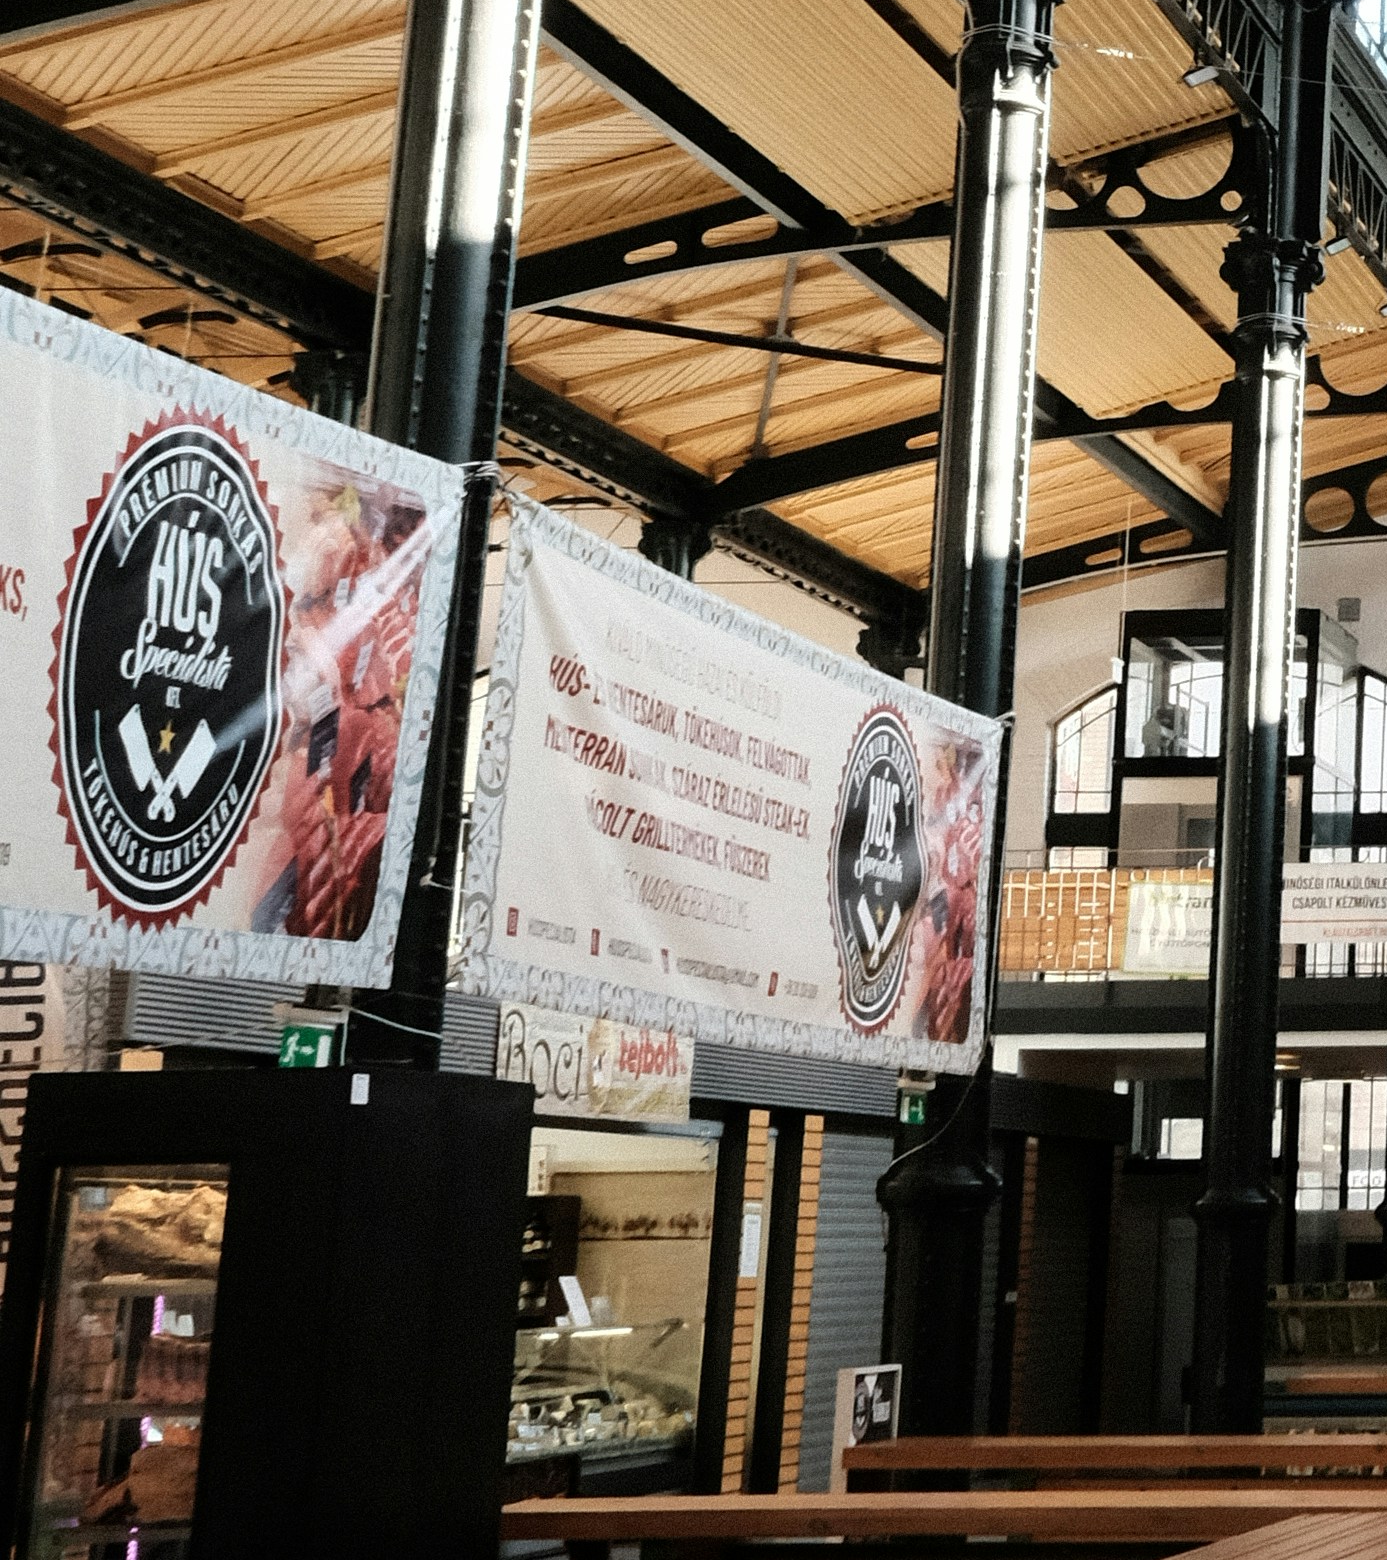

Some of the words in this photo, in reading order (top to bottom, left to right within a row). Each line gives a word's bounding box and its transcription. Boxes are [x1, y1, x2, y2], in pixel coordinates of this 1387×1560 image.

[147, 511, 223, 638] HÚS
[120, 617, 233, 690] Specialista
[548, 652, 591, 697] HÚS-
[867, 766, 900, 848] HÚS
[138, 847, 150, 874] &
[1292, 896, 1333, 910] CSAPOLT
